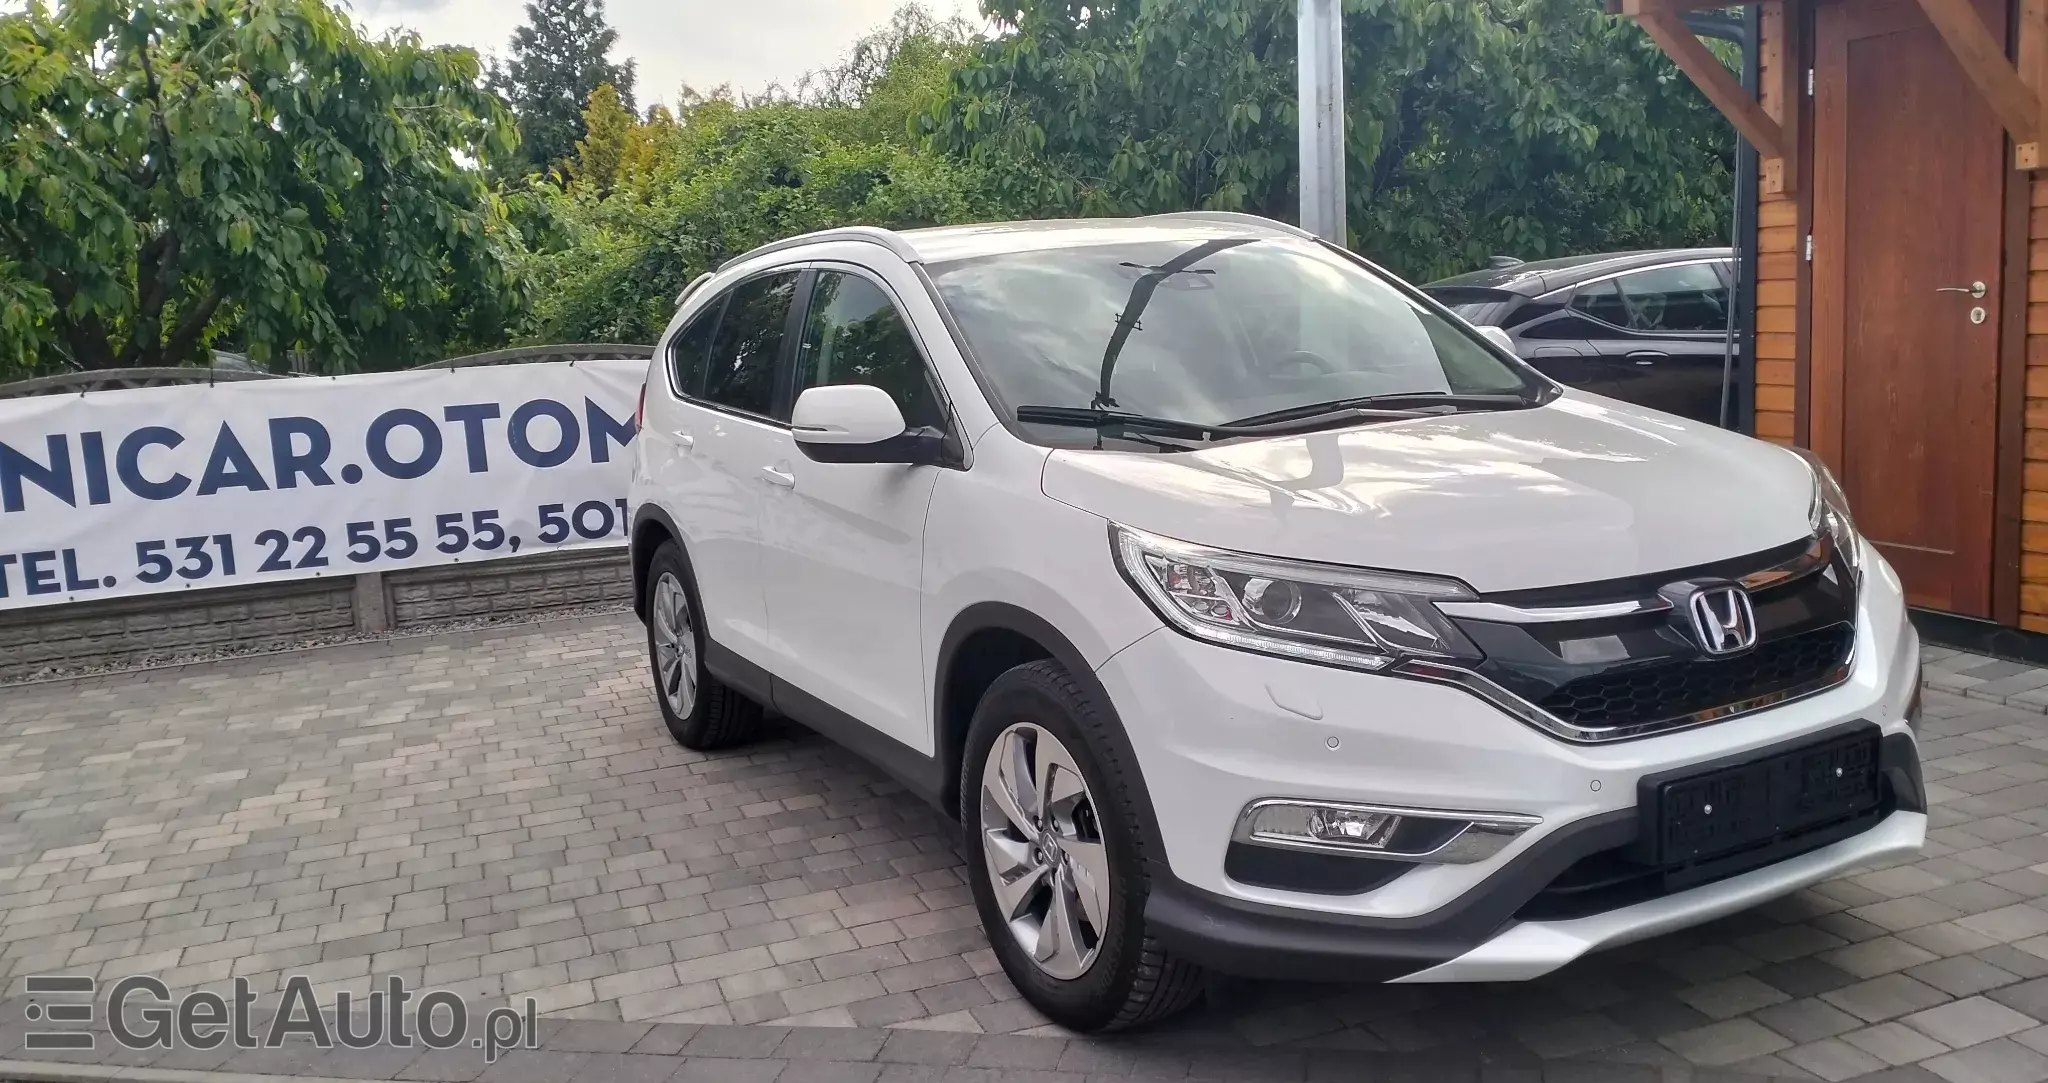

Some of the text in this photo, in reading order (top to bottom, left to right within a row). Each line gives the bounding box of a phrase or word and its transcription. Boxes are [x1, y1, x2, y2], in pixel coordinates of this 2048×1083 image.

[136, 534, 237, 583] 531
[255, 526, 329, 573] 22
[346, 518, 418, 563] 55
[436, 510, 521, 553] 55,
[538, 498, 628, 543] 501
